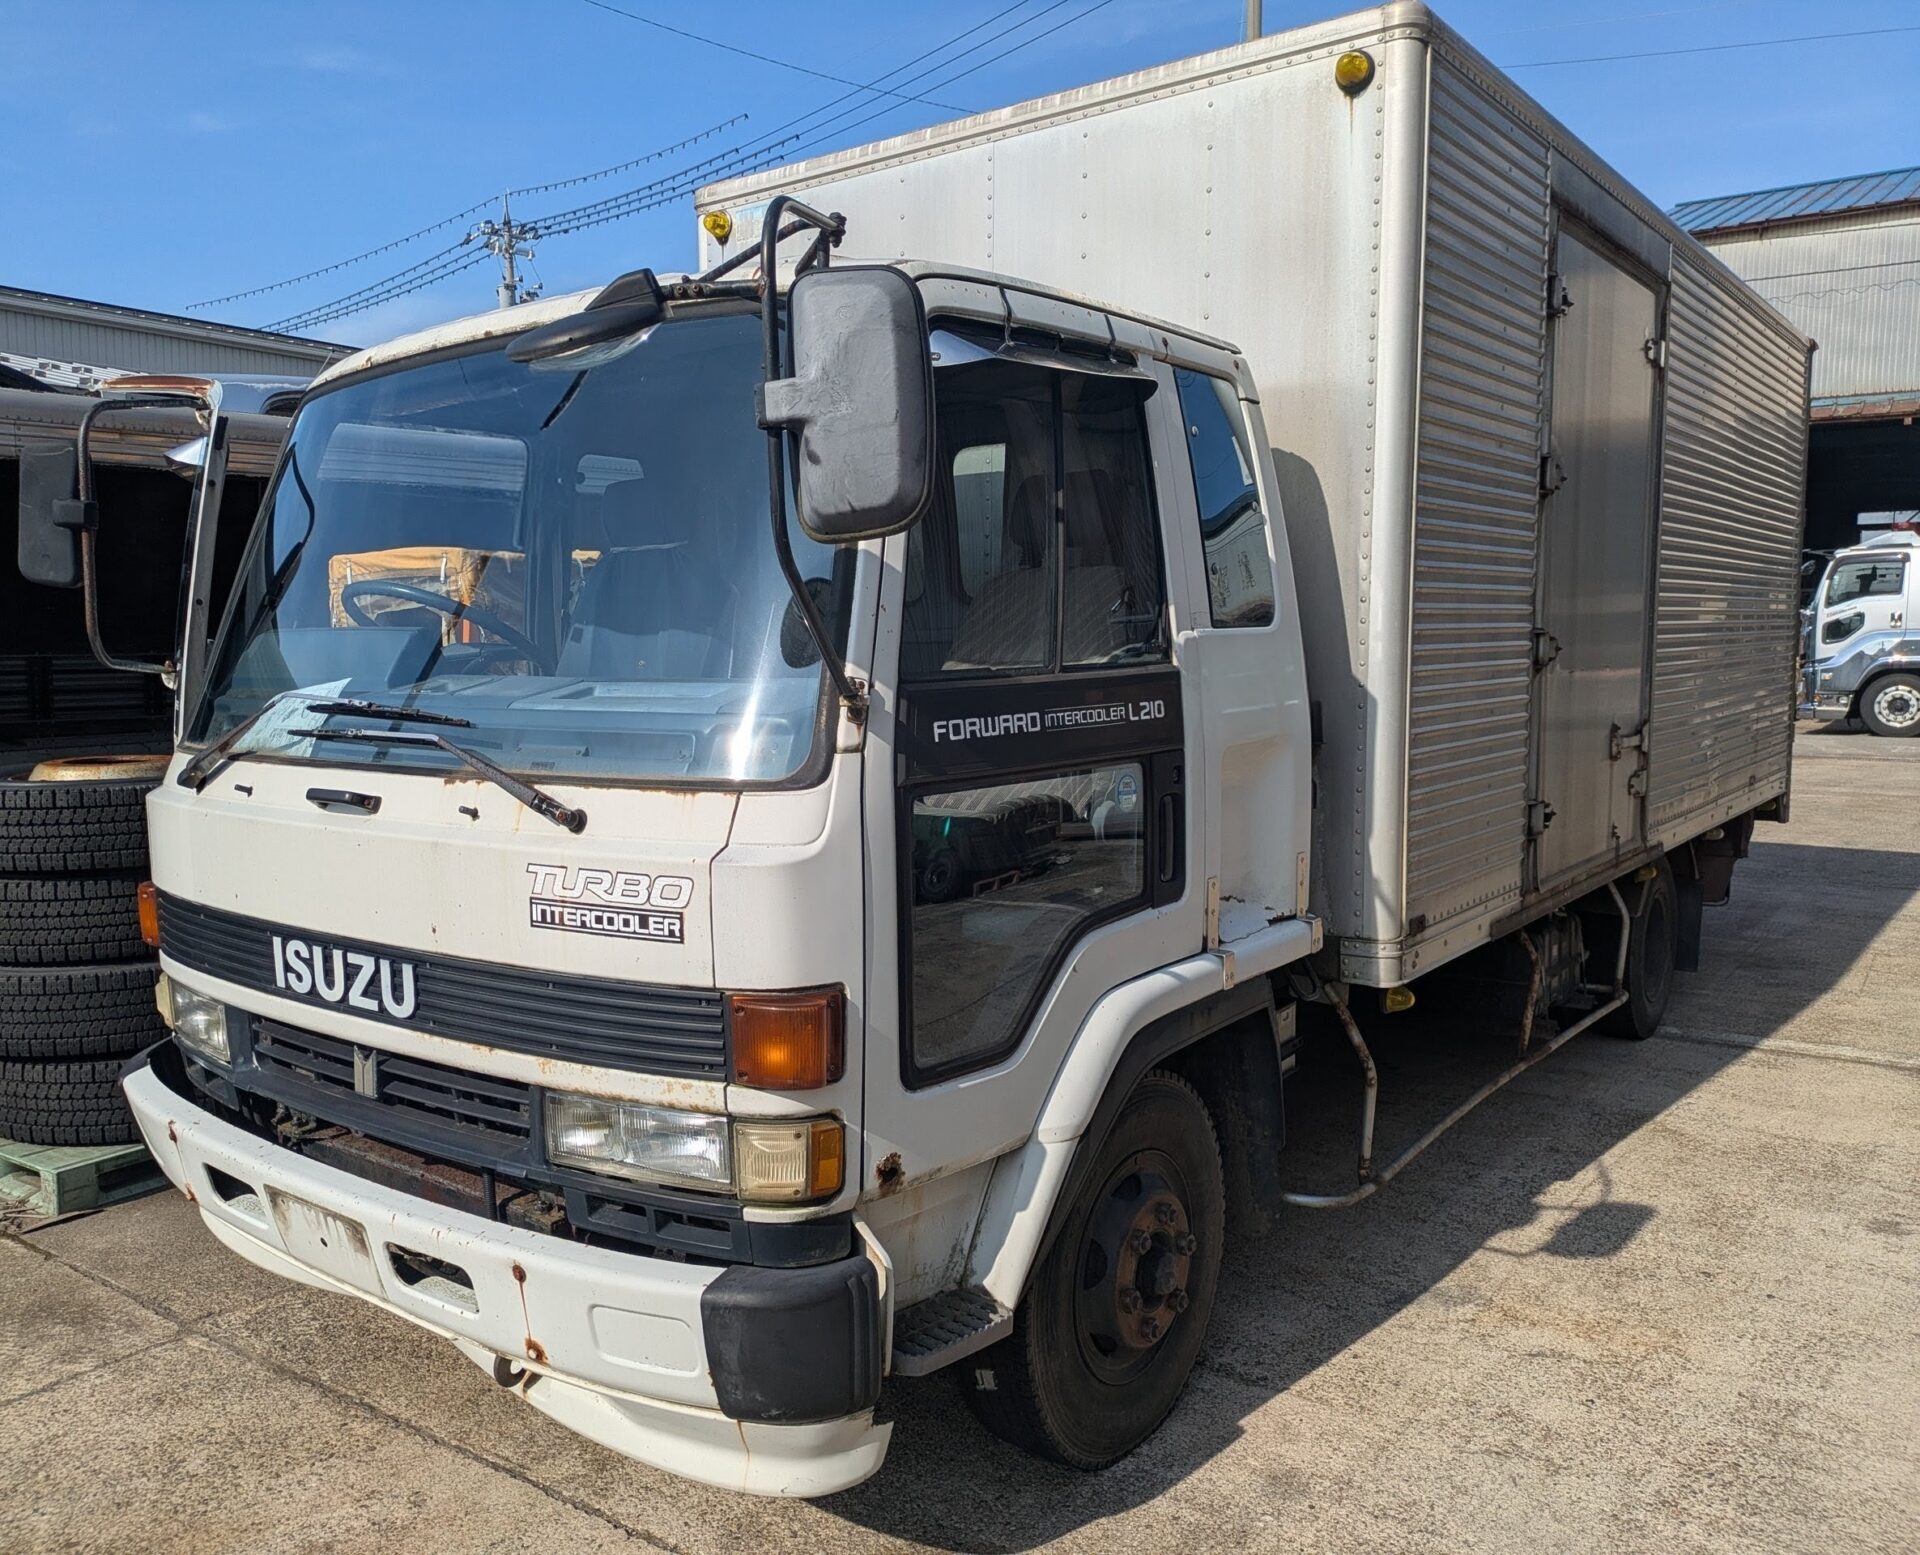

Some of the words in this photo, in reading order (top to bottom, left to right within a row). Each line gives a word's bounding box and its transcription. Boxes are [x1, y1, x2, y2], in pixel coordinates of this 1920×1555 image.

[932, 711, 1041, 742] FORWARD
[1044, 706, 1126, 728] INTERCOOLER
[1128, 700, 1165, 721] L210
[526, 862, 695, 909] TURBO
[531, 903, 681, 937] INTERCOOLER
[272, 935, 416, 1019] ISUZU
